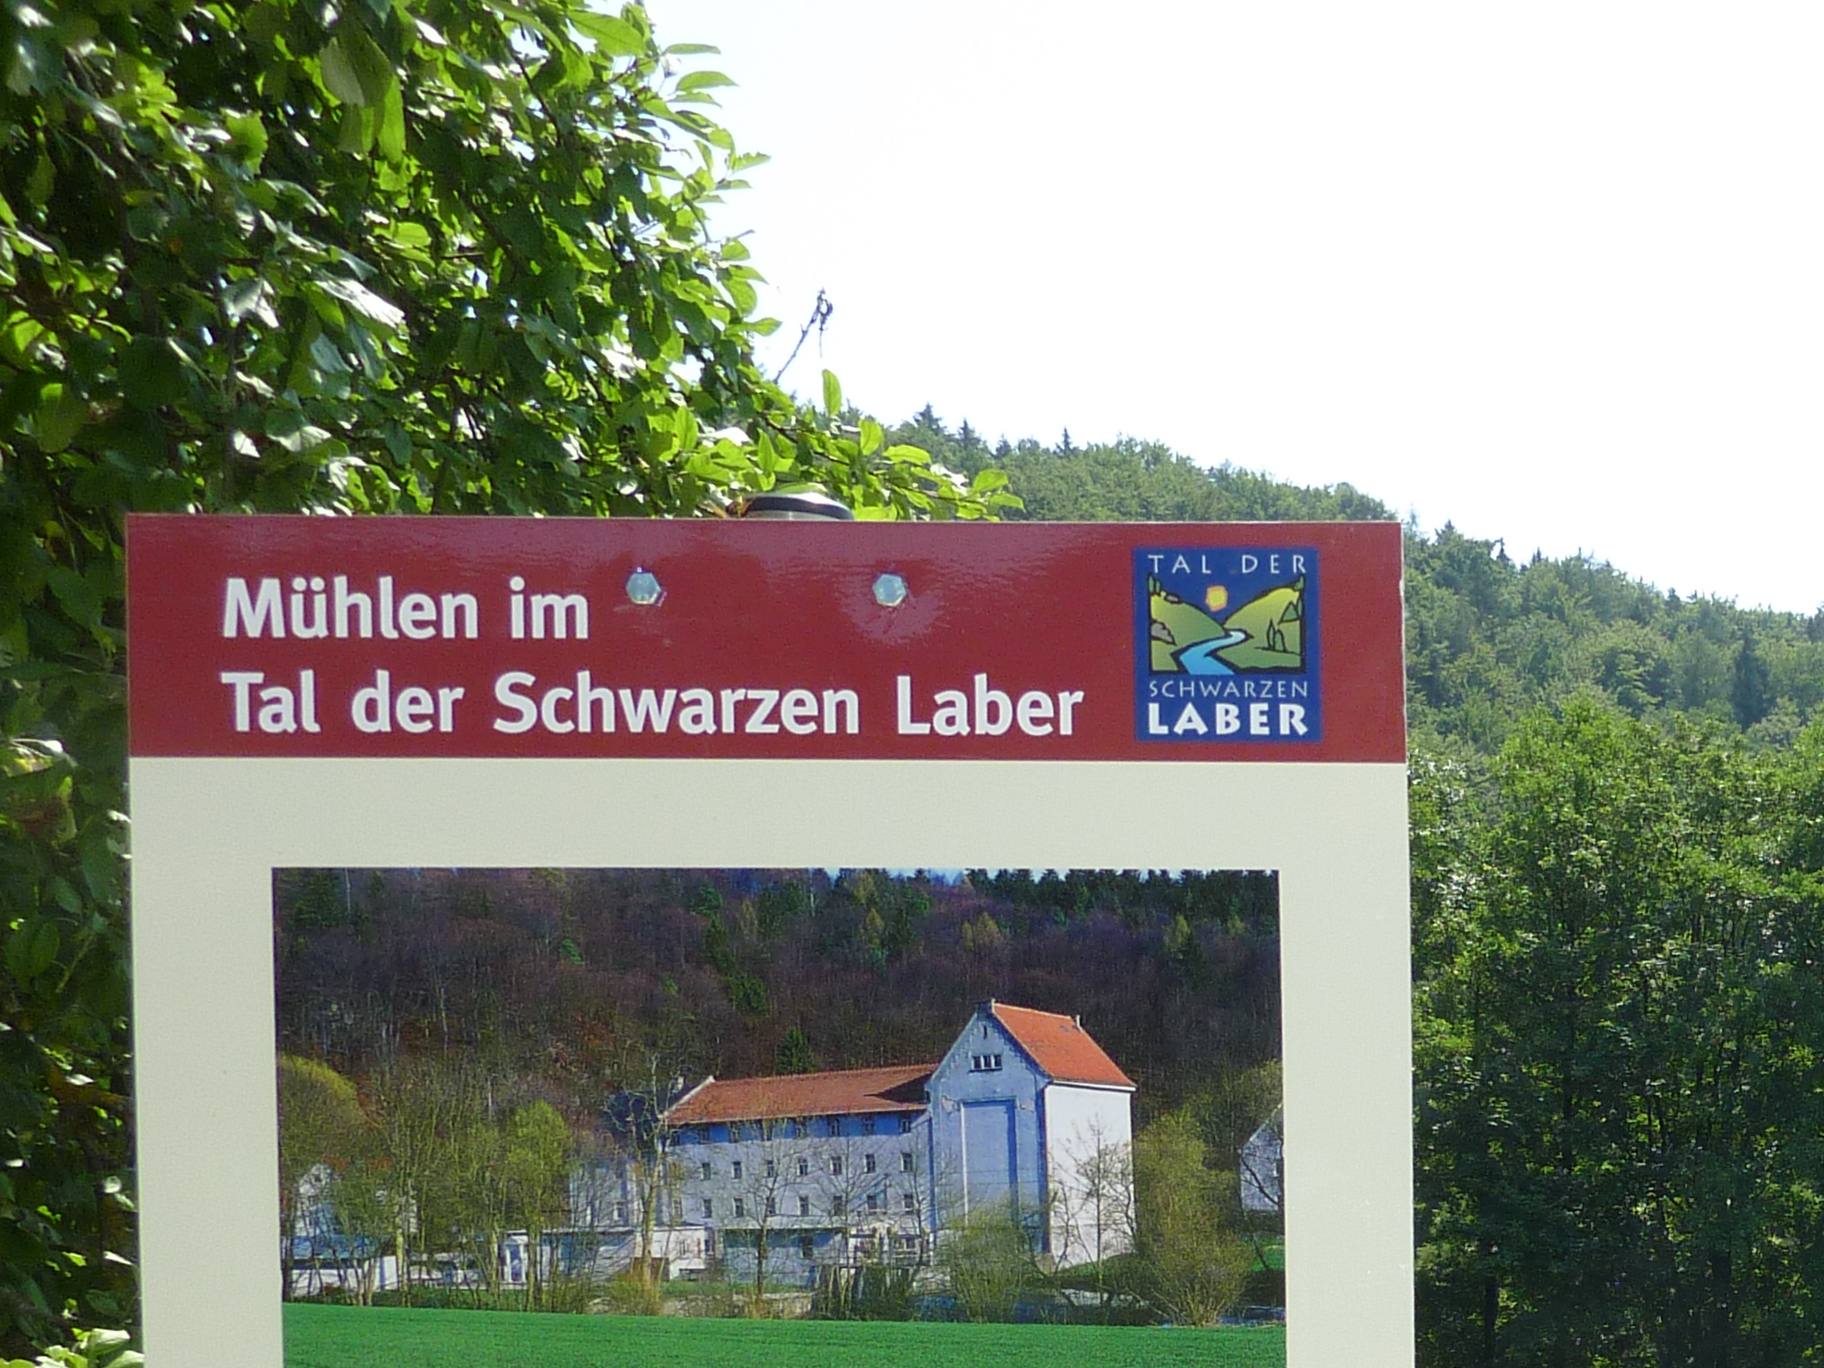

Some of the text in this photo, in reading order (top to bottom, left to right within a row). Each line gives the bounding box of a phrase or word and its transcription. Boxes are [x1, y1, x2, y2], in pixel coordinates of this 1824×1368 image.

[1147, 554, 1306, 574] TAL DER
[222, 574, 589, 640] Mühlen im
[220, 668, 1085, 737] Tal der Schwarzen Laber
[1149, 680, 1308, 699] SCHWARZEN
[1148, 701, 1308, 736] LABER
